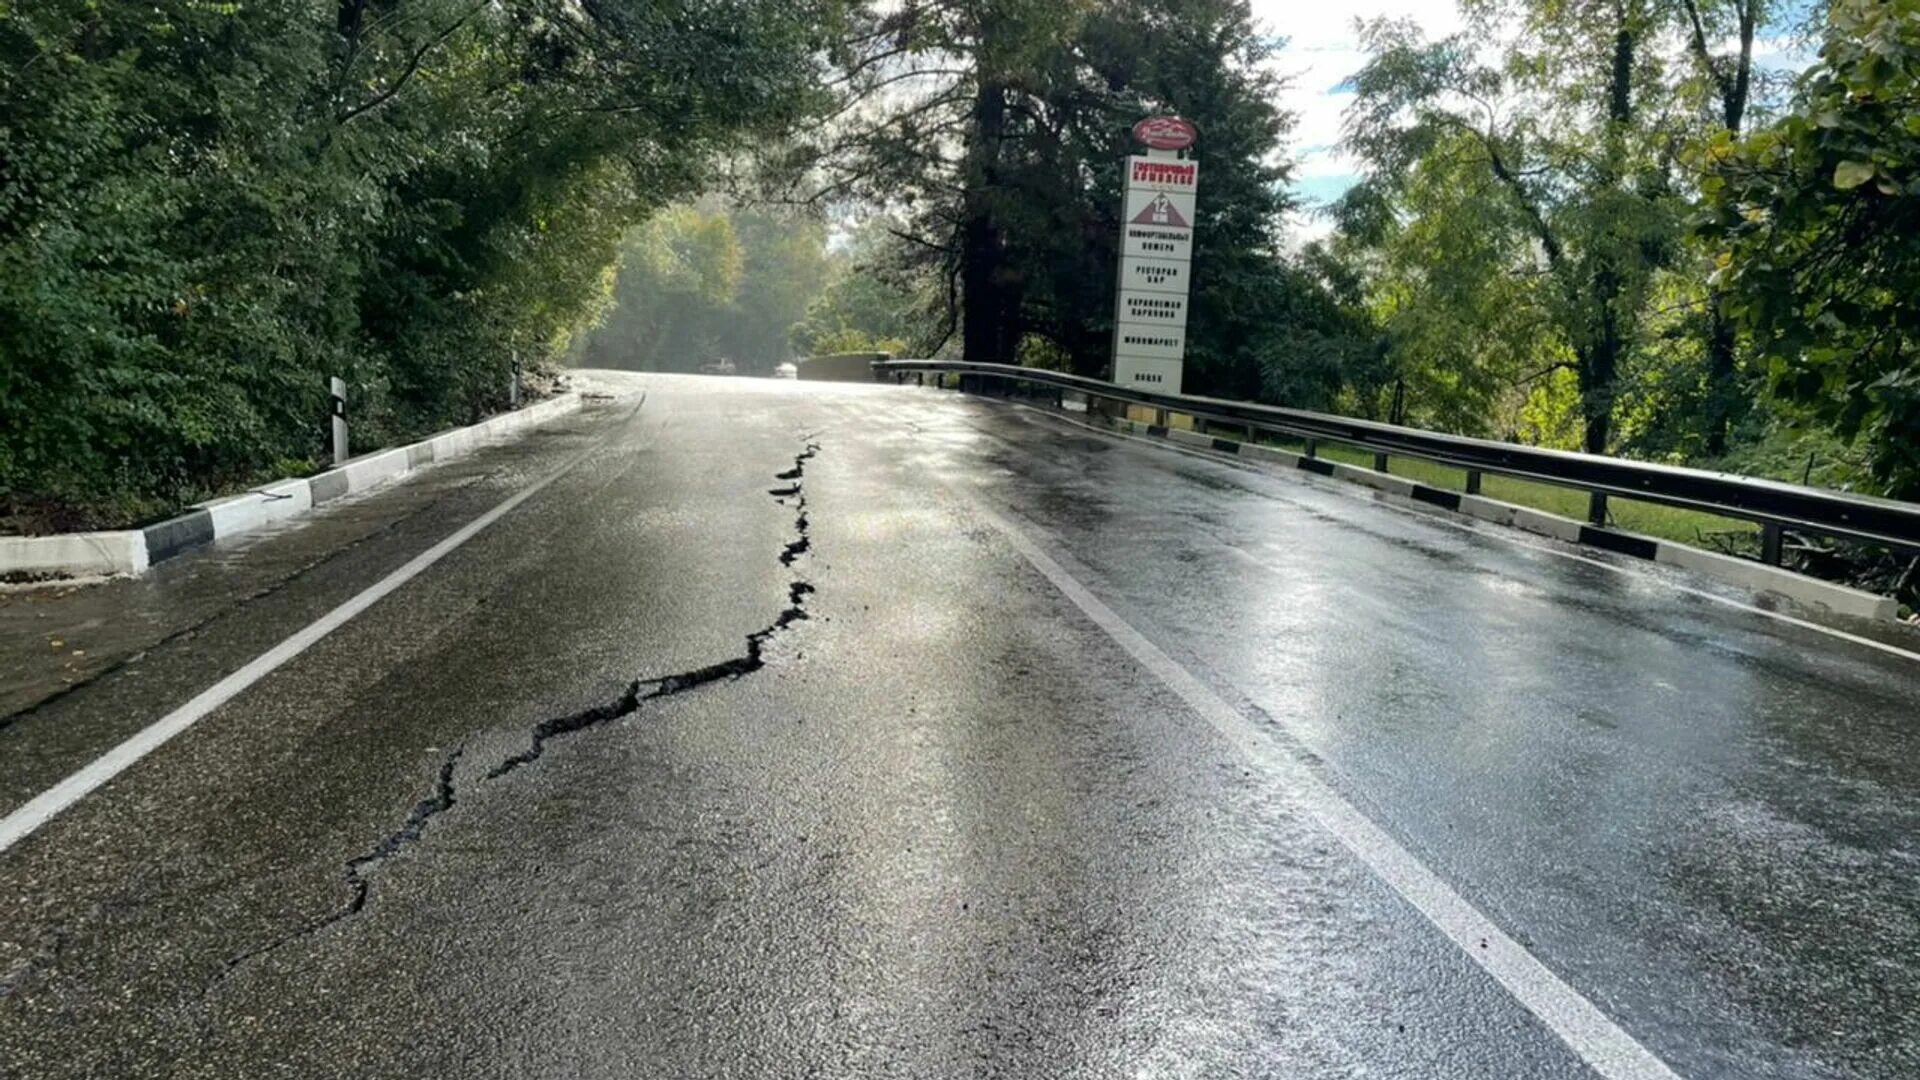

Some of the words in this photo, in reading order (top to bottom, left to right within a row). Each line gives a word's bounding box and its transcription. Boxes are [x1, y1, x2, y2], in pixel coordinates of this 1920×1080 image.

[1153, 198, 1168, 213] 12
[1142, 242, 1174, 252] НОМЕРА
[1136, 266, 1177, 276] РЕСТОРАН
[1147, 275, 1165, 284] БАР
[1132, 308, 1175, 318] ПАРКОВКА
[1124, 336, 1178, 347] МИНИМАРКЕТ
